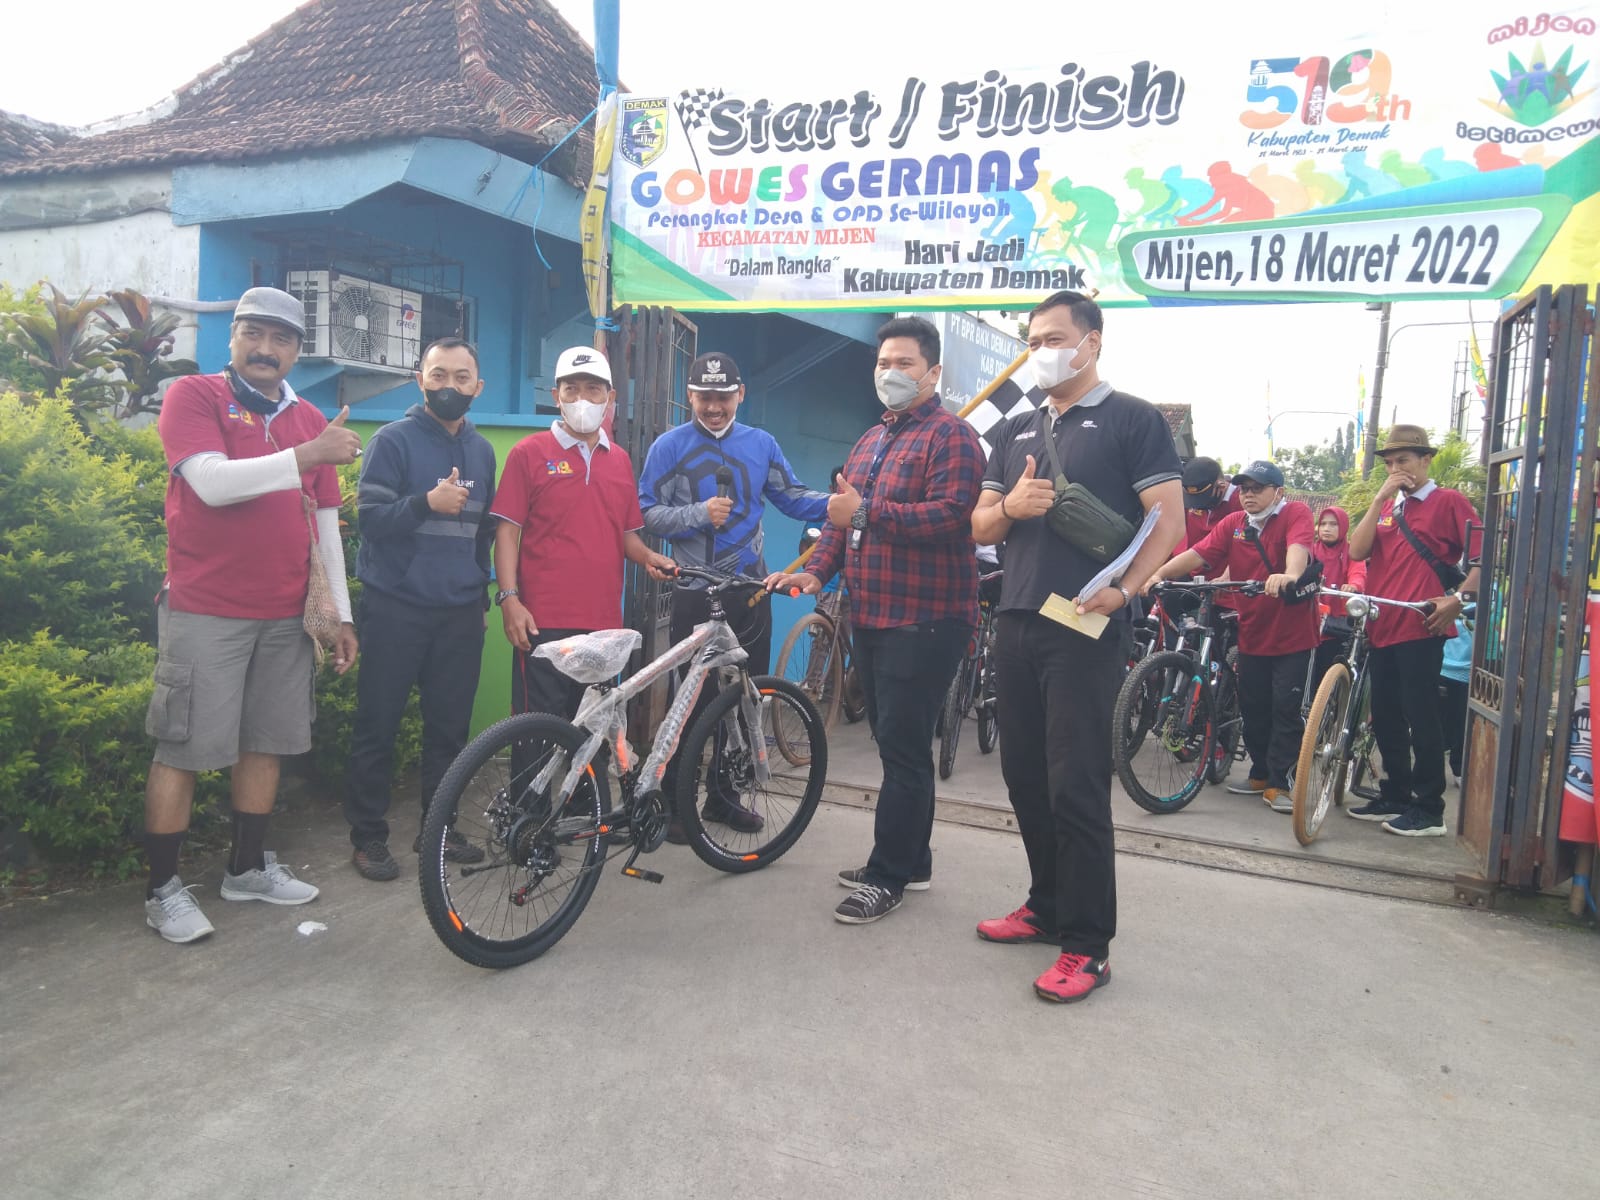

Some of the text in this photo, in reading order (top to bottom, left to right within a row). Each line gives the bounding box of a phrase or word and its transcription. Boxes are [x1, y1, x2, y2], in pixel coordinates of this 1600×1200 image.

[1487, 12, 1596, 45] mijen
[626, 100, 666, 110] DEMAK
[707, 60, 1185, 156] Start / Finish
[1247, 123, 1391, 150] Kabupaten Demak
[630, 147, 1040, 208] GOWES GERMAS
[648, 199, 1011, 231] Perangkat Desa & OPD Se-Wilayah
[697, 227, 877, 248] KECAMATAN MIJEN
[905, 238, 1025, 265] Hari Jadi
[1295, 231, 1401, 283] Maret
[1406, 224, 1500, 285] 2022
[843, 265, 1087, 296] Kabupaten Demak
[951, 313, 961, 336] PT
[961, 318, 975, 344] BPR
